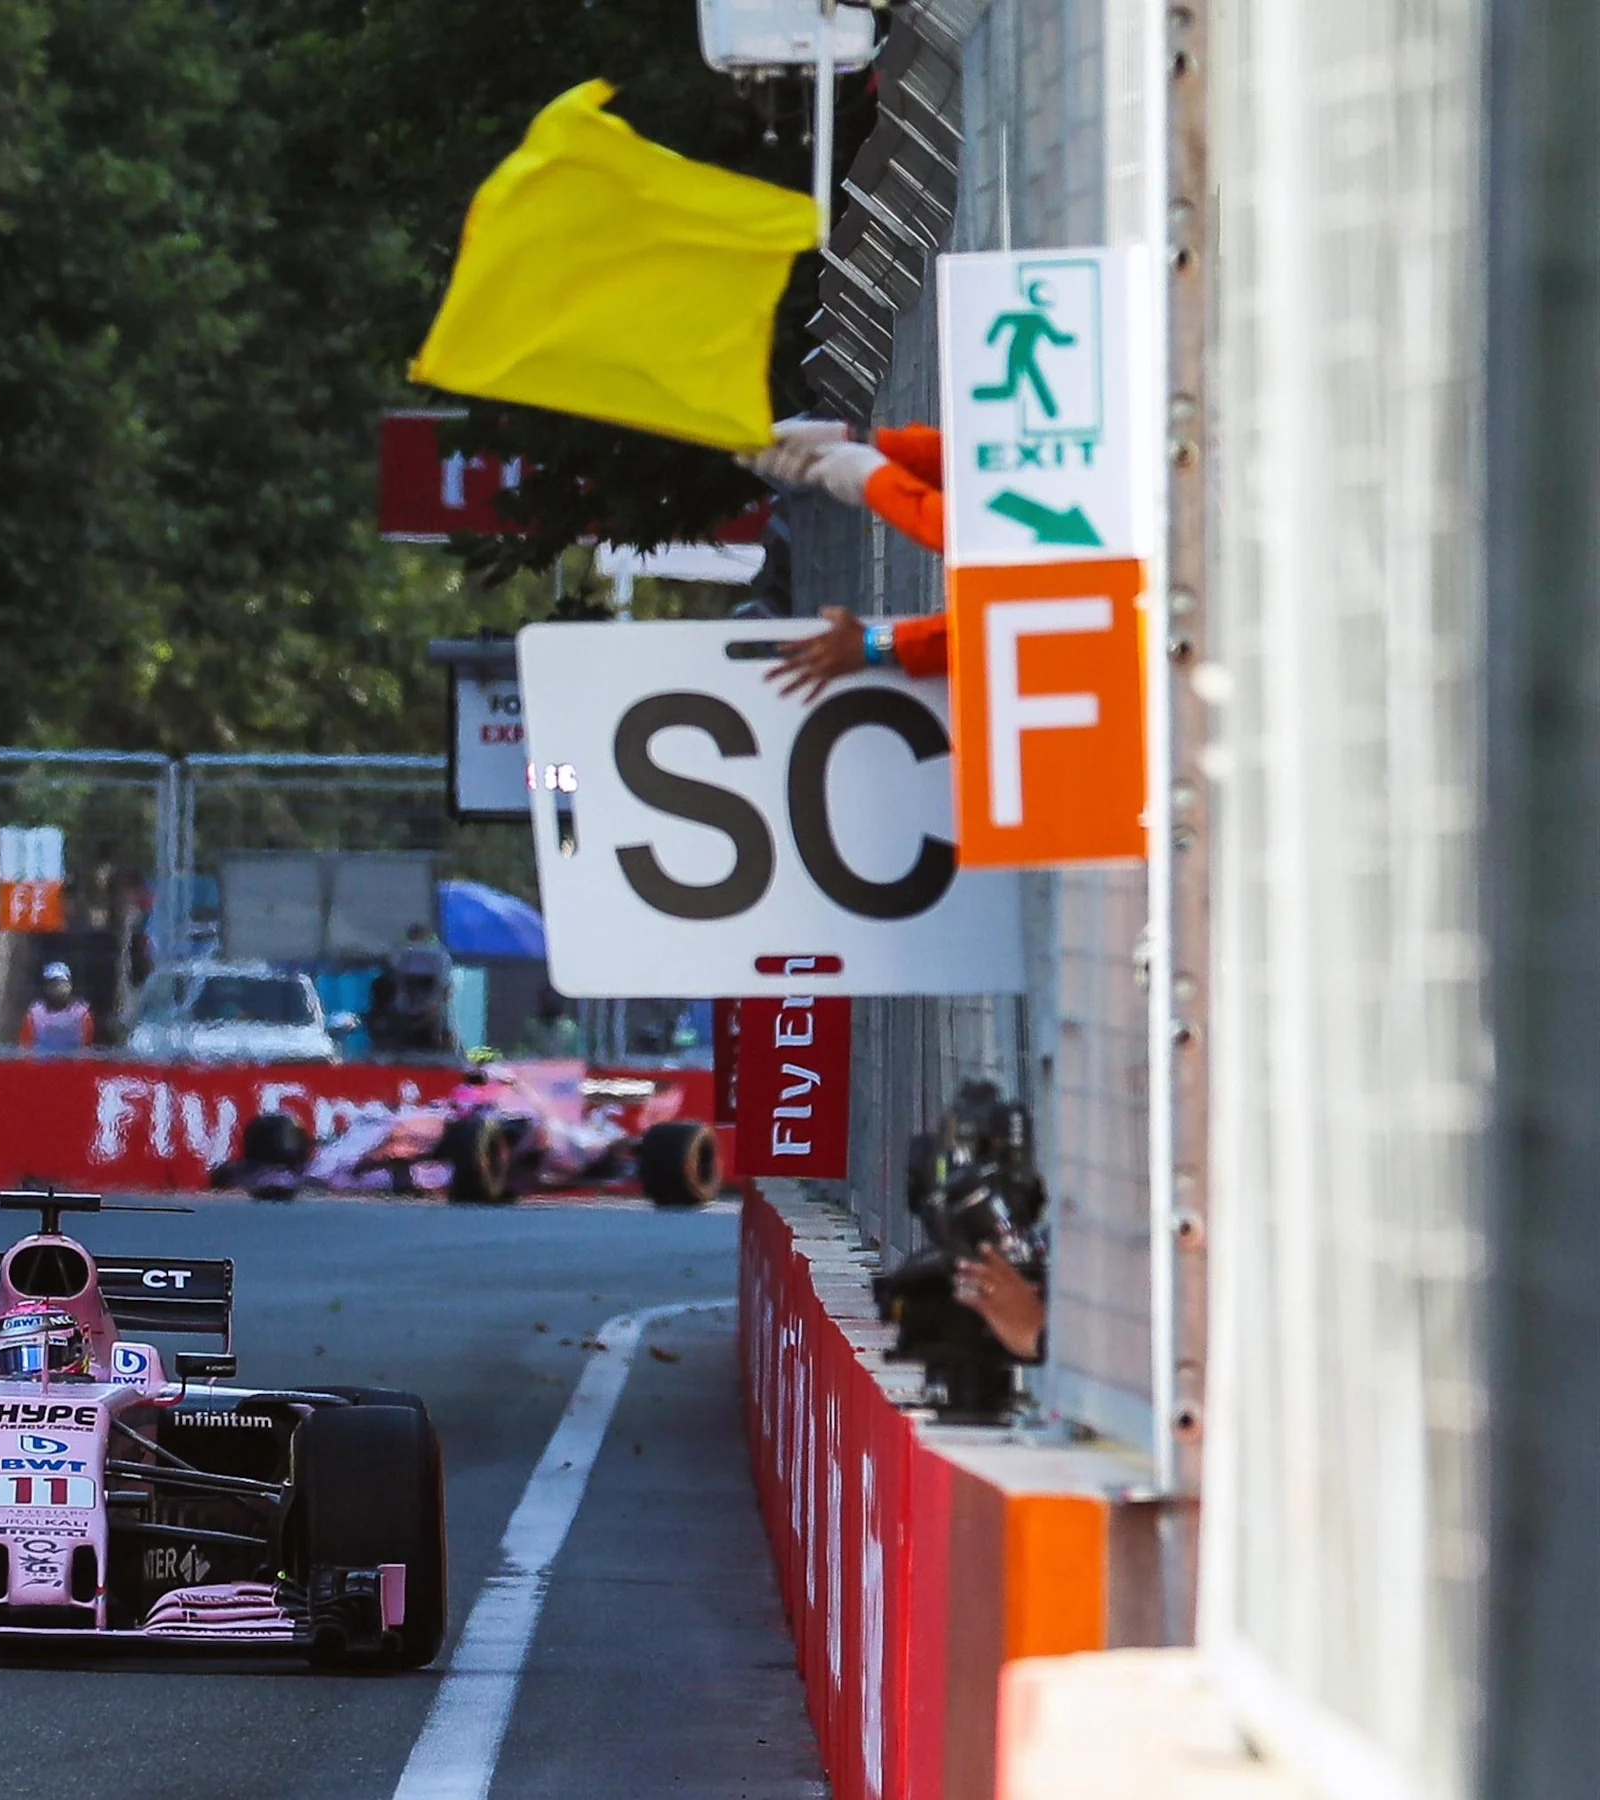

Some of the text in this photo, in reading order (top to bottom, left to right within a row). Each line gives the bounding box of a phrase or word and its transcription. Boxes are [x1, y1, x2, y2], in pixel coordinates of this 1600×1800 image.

[976, 440, 1100, 472] EXIT
[984, 596, 1113, 829] F
[613, 686, 960, 921] SC
[90, 1075, 239, 1172] Fly
[771, 1062, 822, 1157] Fly
[142, 1268, 193, 1290] CT
[174, 1410, 273, 1429] infinitum
[1, 1459, 88, 1473] BWT
[8, 1476, 69, 1505] 11
